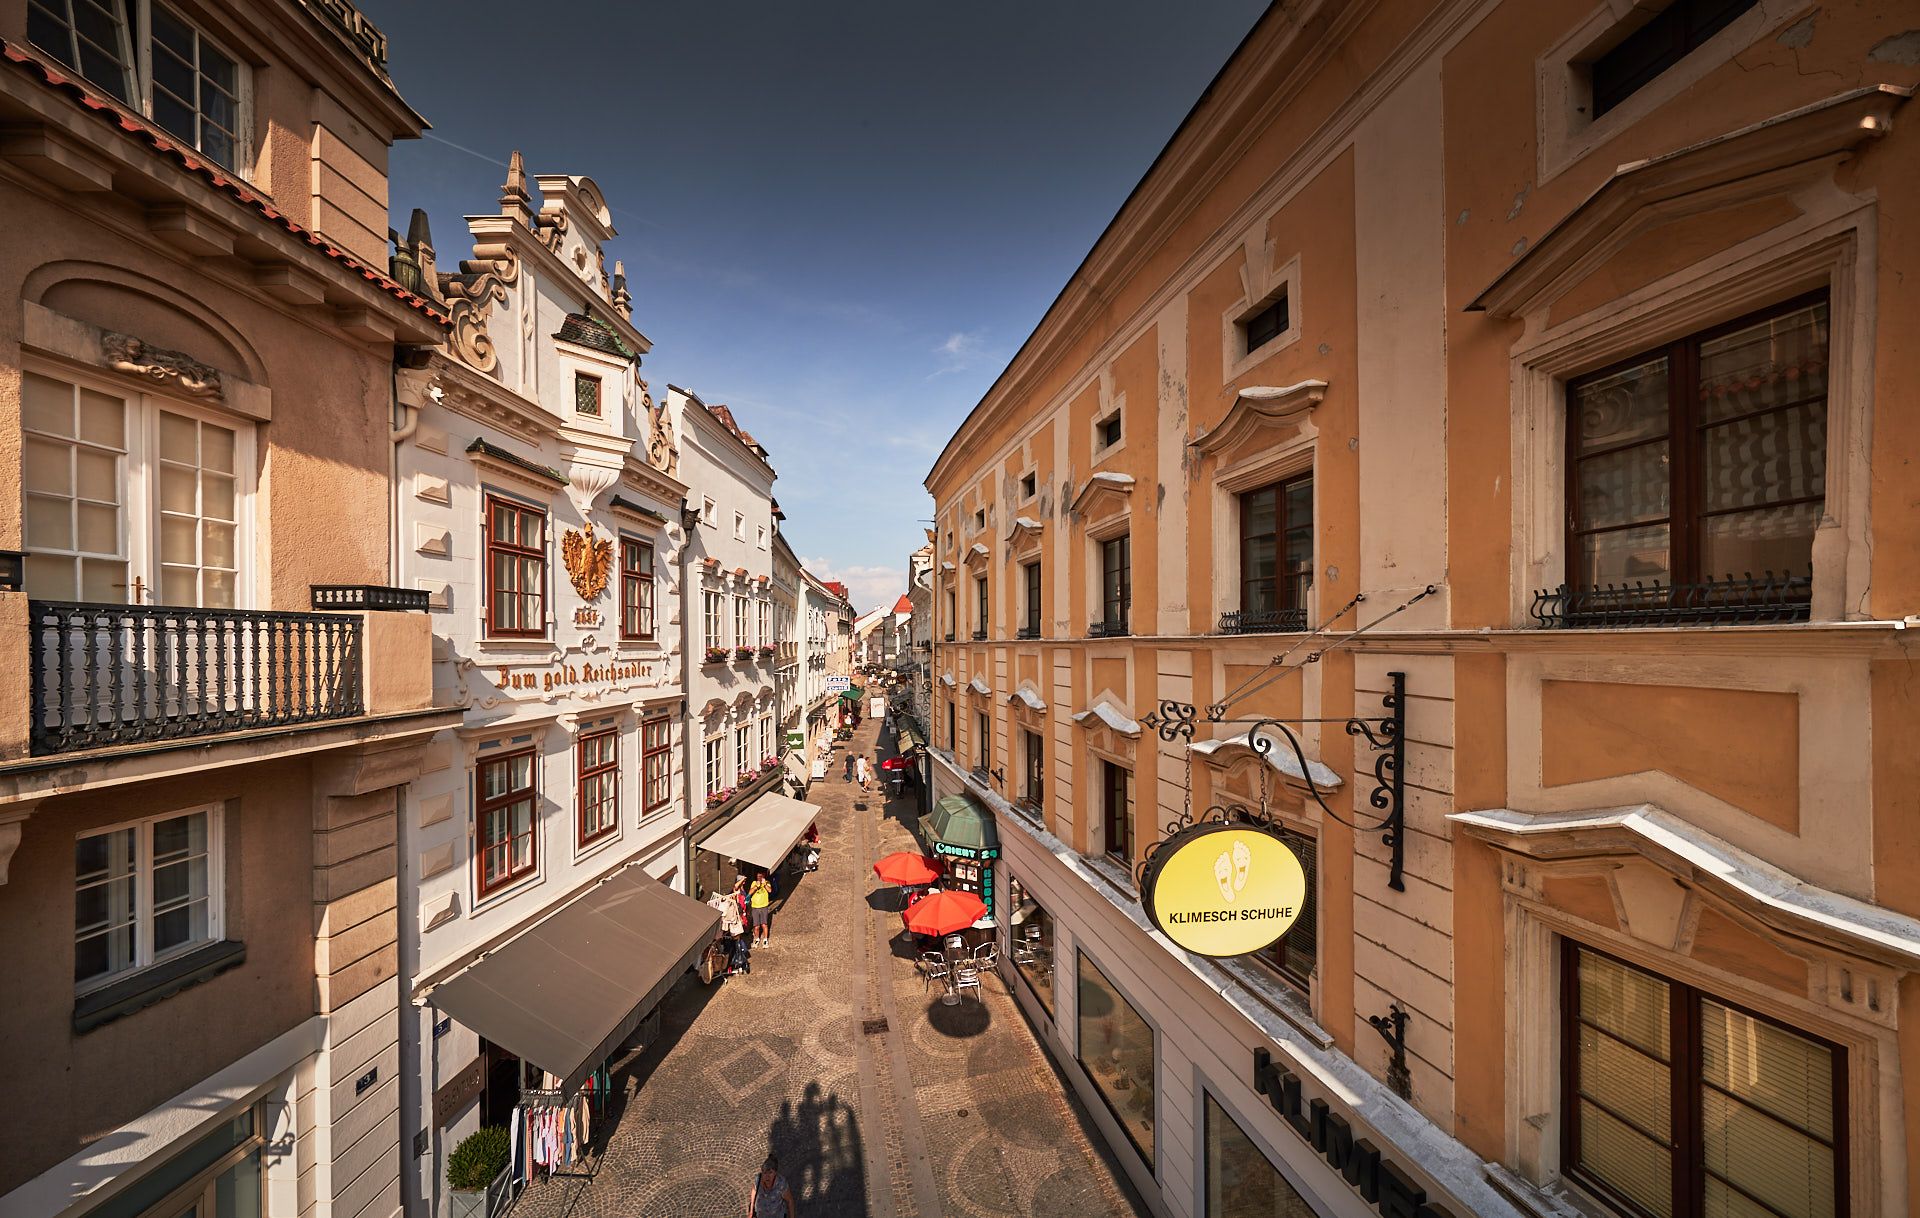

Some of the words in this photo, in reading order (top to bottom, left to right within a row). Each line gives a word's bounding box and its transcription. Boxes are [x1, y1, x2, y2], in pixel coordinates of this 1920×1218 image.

[495, 665, 537, 690] Zum
[582, 661, 652, 685] Reichsadler
[981, 849, 998, 860] 24
[1169, 909, 1237, 924] KLIMESCH
[1240, 907, 1293, 921] SCHUHE
